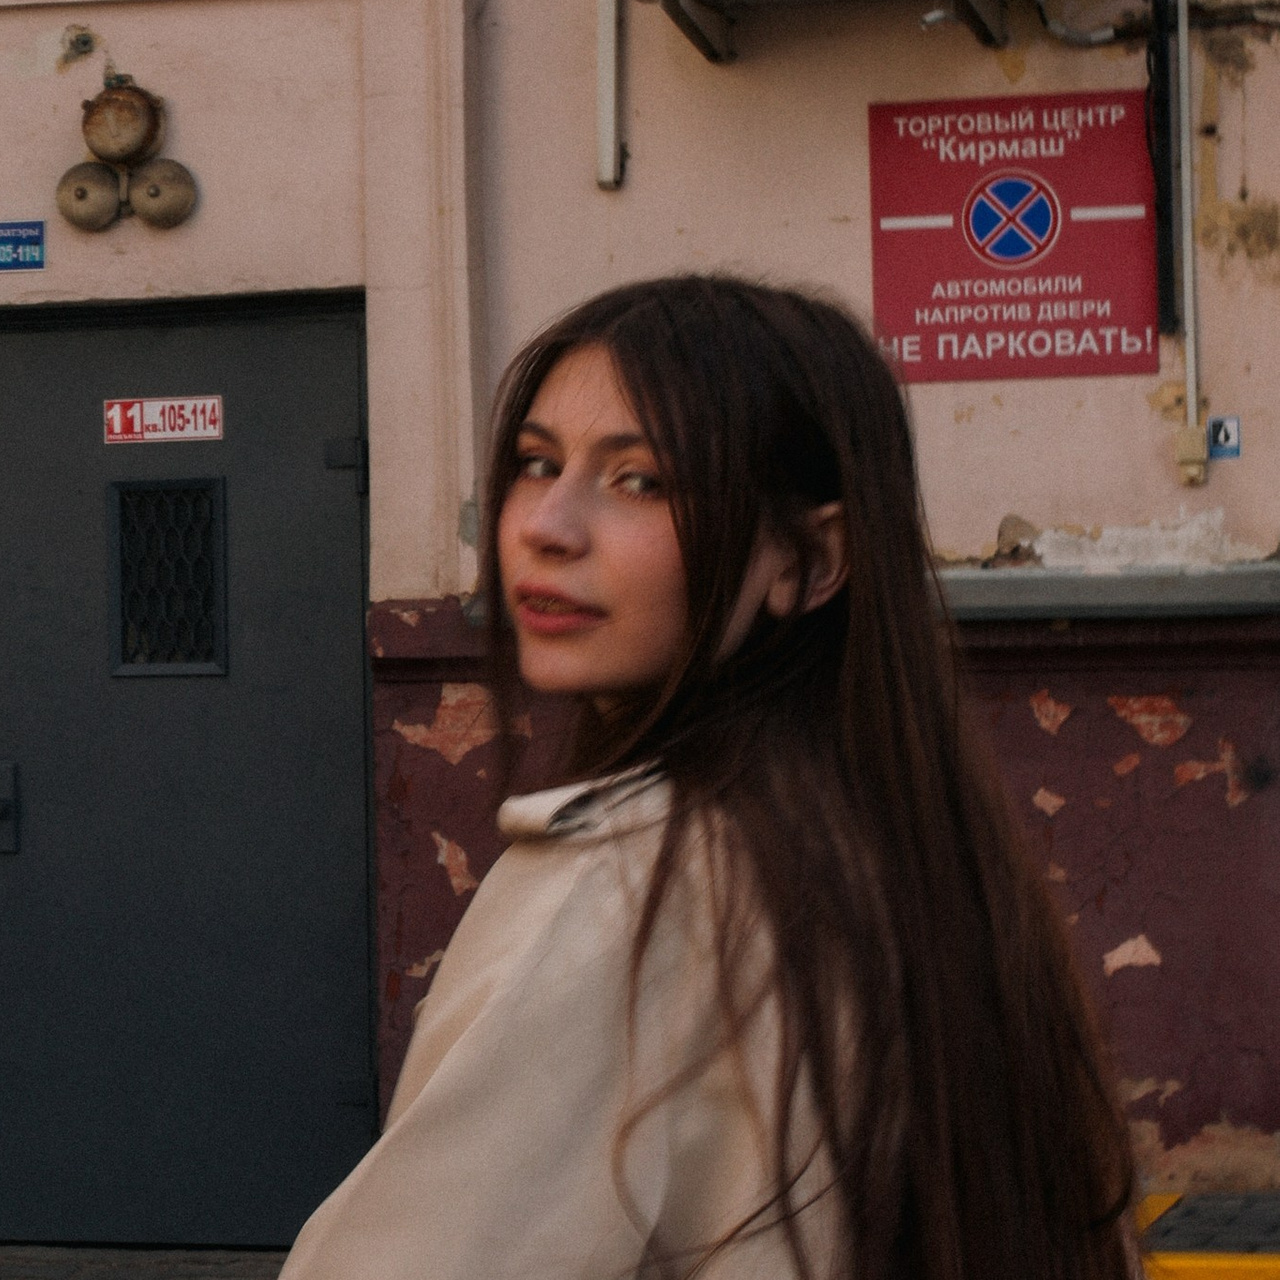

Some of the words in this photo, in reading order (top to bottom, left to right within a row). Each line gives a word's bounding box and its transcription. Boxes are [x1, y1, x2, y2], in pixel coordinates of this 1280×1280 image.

[893, 107, 1034, 138] ТОРГОВЫЙ
[1042, 104, 1126, 132] ЦЕНТР
[932, 275, 1083, 300] АВТОМОБИЛИ
[915, 304, 1031, 326] НАПРОТИВ
[1037, 299, 1111, 322] ДВЕРИ
[878, 334, 922, 363] НЕ
[937, 326, 1153, 361] ПАРКОВАТЬ!
[107, 403, 141, 434] 11
